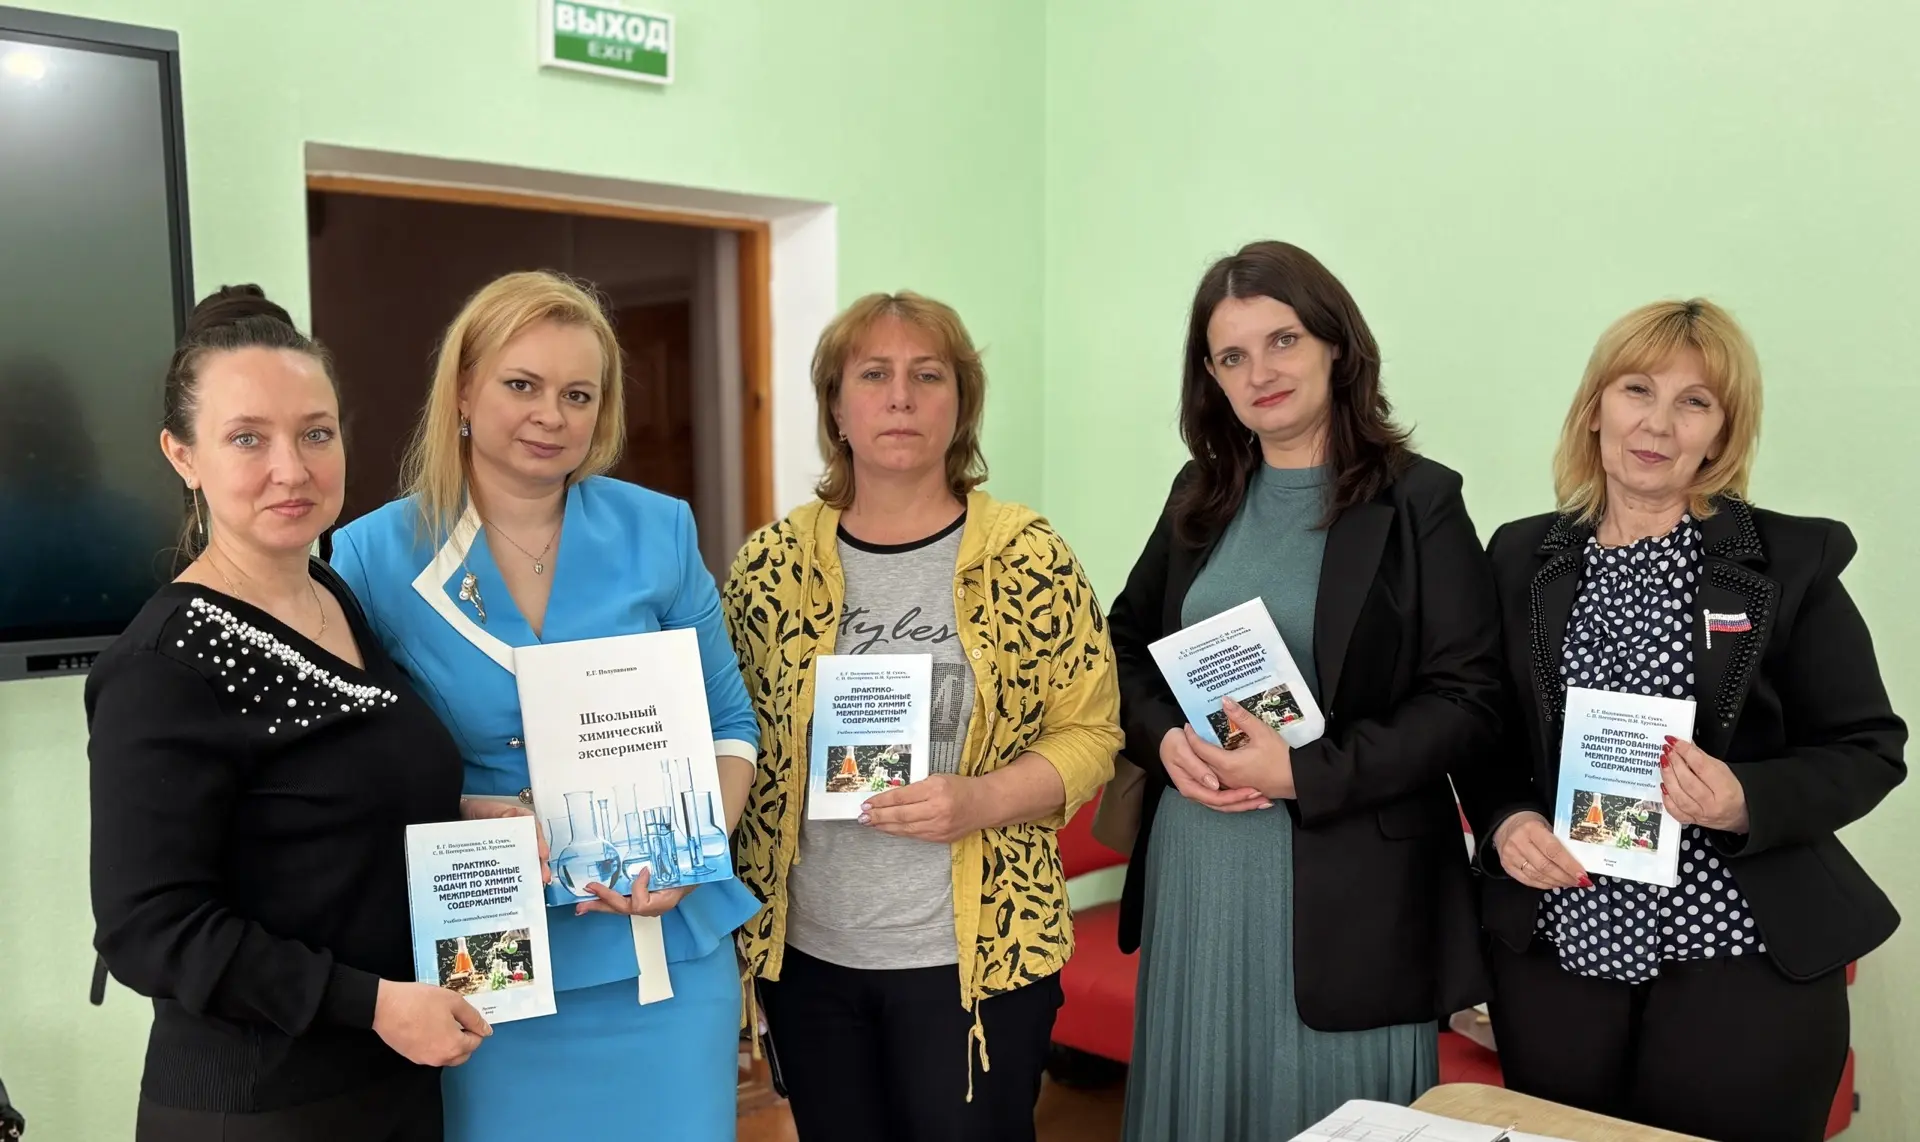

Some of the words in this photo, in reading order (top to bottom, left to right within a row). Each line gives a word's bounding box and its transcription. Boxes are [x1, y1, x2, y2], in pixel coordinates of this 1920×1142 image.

[556, 4, 669, 54] ВЫХОД
[587, 40, 634, 63] EXIT
[1187, 643, 1262, 678] ОРИЕНТИРОВАННЫЕ
[1199, 645, 1242, 664] ПРАКТИКО-
[1189, 669, 1218, 685] ЗАДАЧИ
[1220, 663, 1231, 672] ПО
[1233, 652, 1261, 667] ХИМИИ
[1196, 657, 1266, 689] МЕЖПРЕДМЕТНЫМ
[1206, 665, 1263, 692] СОДЕРЖАНИЕМ
[580, 704, 658, 726] Школьный
[842, 716, 900, 724] СОДЕРЖАНИЕМ
[578, 720, 664, 742] химический
[1602, 728, 1648, 740] ПРАКТИКО-
[578, 740, 668, 760] эксперимент
[1581, 742, 1612, 753] ЗАДАЧИ
[1629, 750, 1659, 759] ХИМИИ
[1584, 734, 1662, 750] ОРИЕНТИРОВАННЫ
[1585, 752, 1660, 768] МЕЖПРЕДМЕТНЫМ
[1591, 761, 1652, 776] СОДЕРЖАНИЕМ
[452, 859, 500, 871] ПРАКТИКО-
[434, 866, 520, 883] ОРИЕНТИРОВАННЫЕ
[433, 882, 467, 892] ЗАДАЧИ
[470, 880, 482, 888] ПО
[484, 876, 515, 886] ХИМИИ
[518, 875, 522, 883] С
[439, 885, 518, 901] МЕЖПРЕДМЕТНЫМ
[448, 895, 512, 910] СОДЕРЖАНИЕМ
